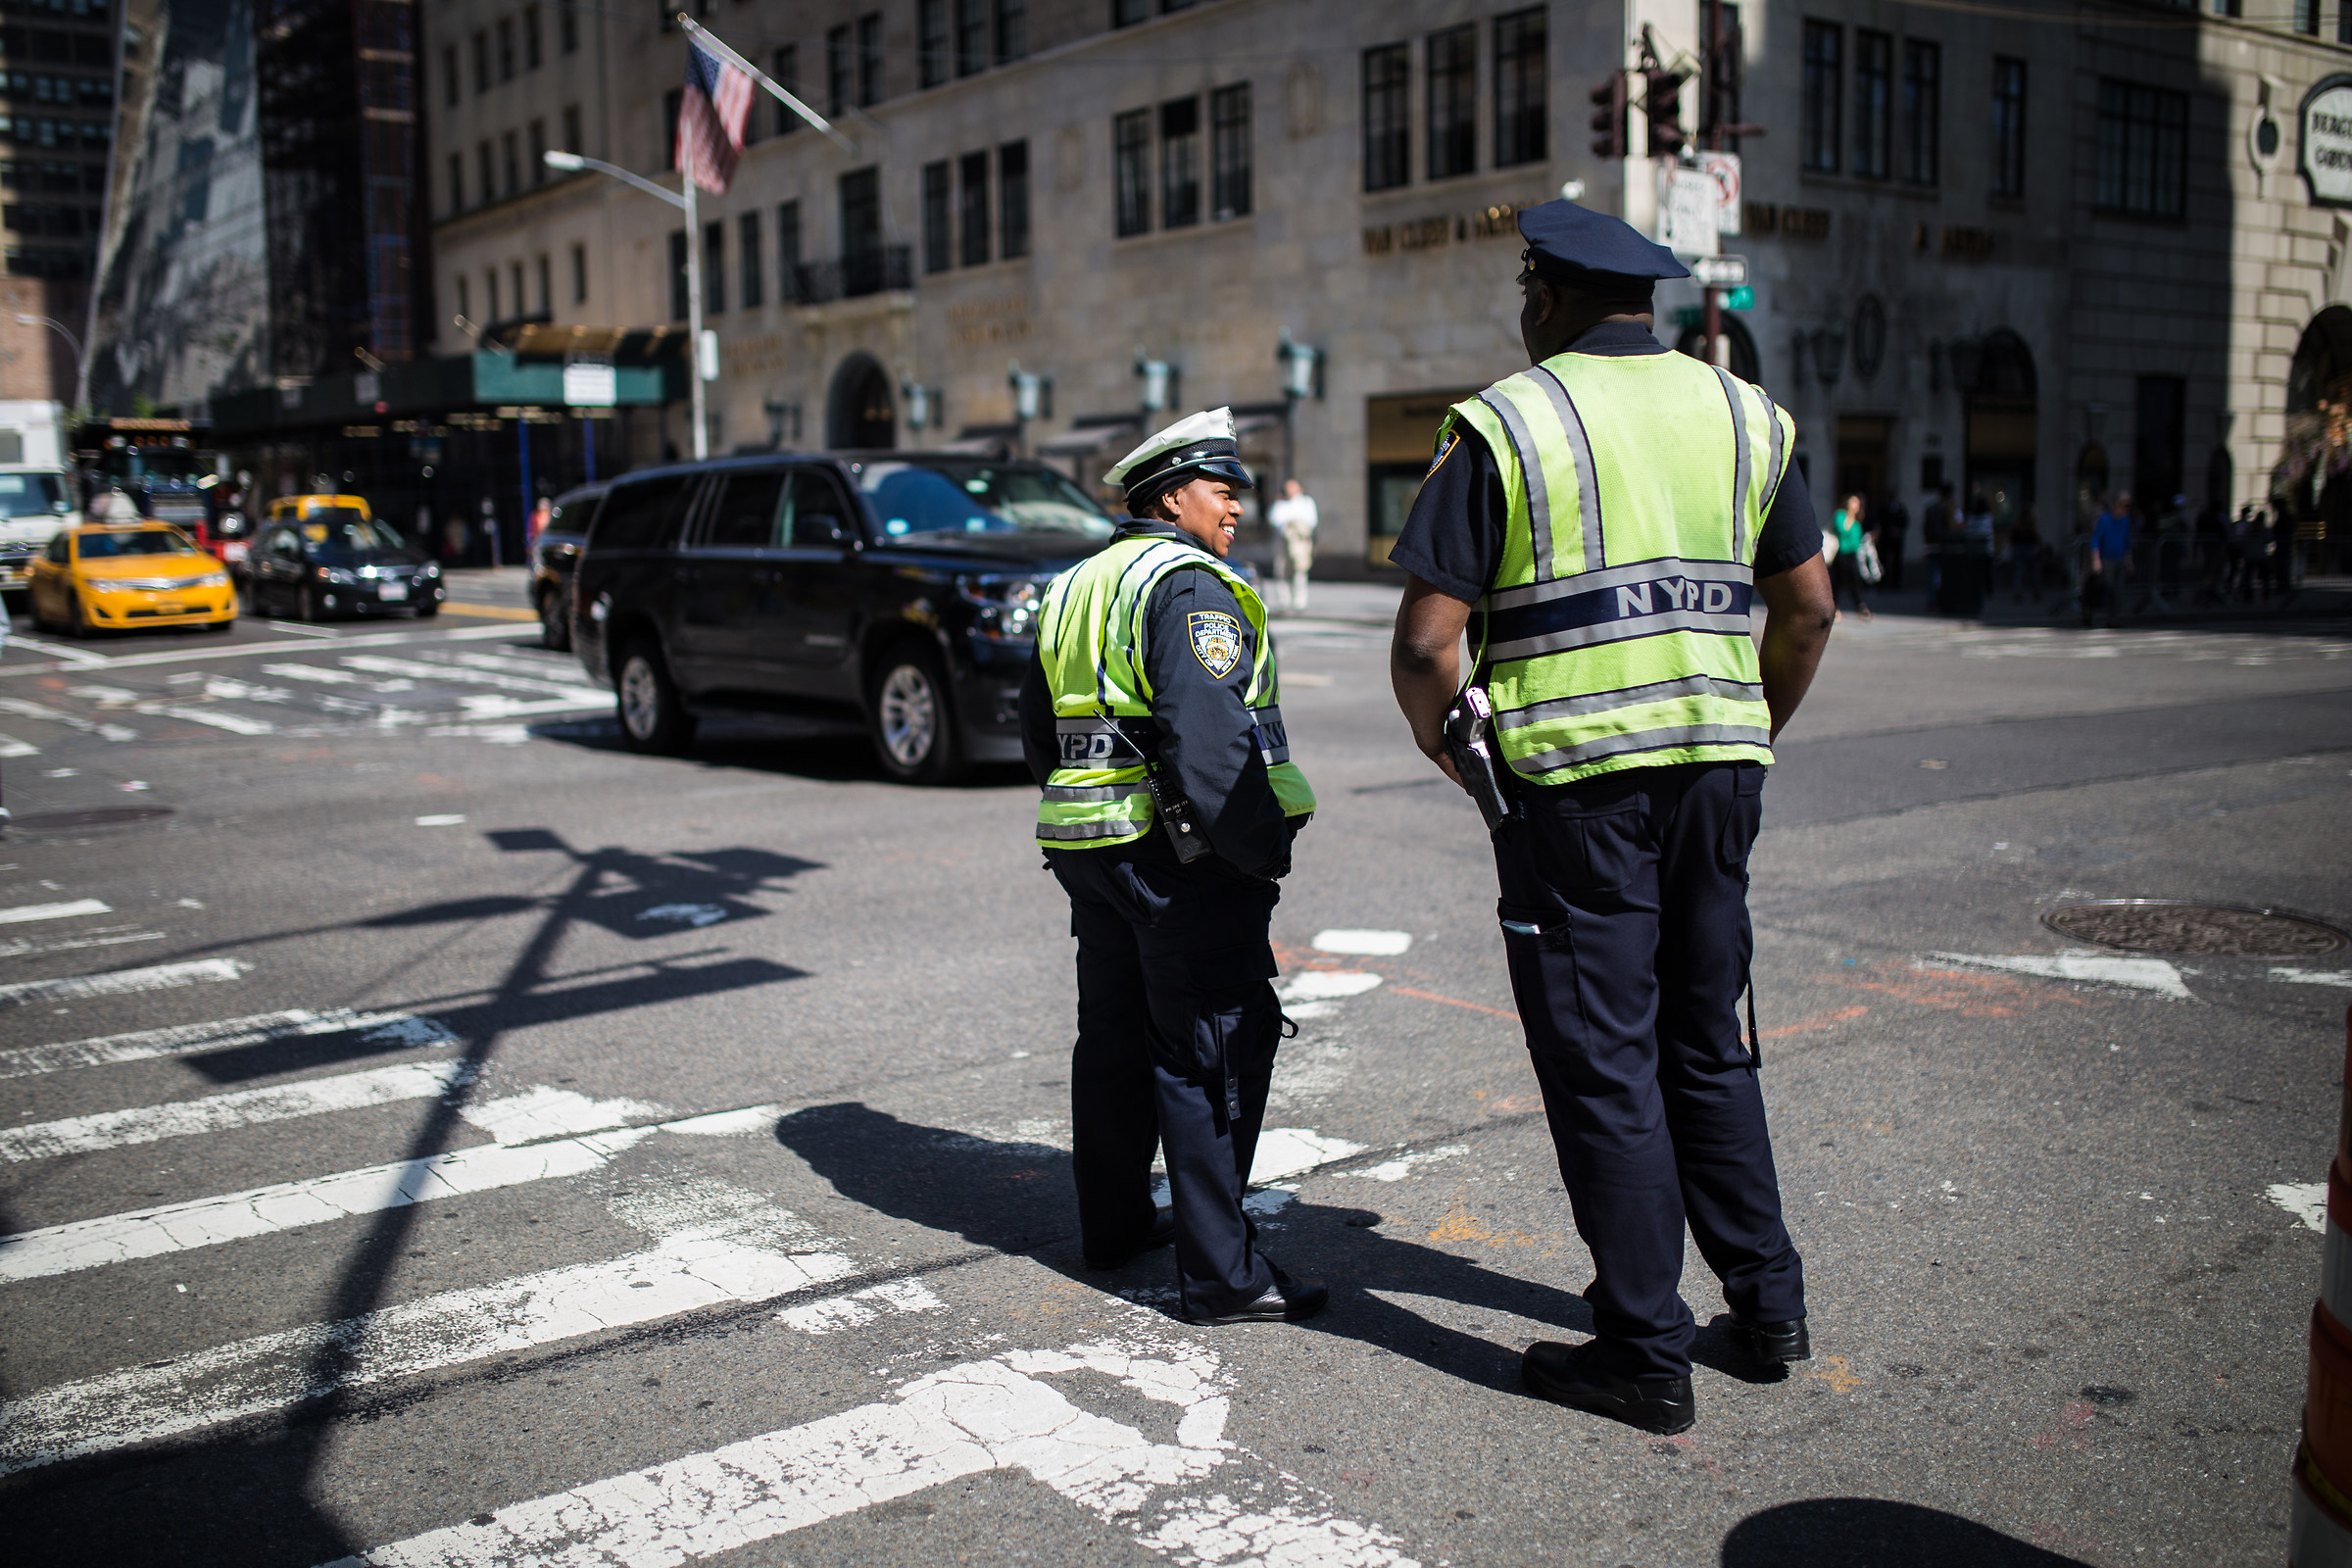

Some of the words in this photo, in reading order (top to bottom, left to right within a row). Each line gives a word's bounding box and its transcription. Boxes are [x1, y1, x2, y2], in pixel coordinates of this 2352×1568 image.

[1616, 577, 1733, 617] NYPD
[1199, 613, 1231, 623] TRAFFIC
[1204, 622, 1229, 632] POLICE
[1196, 629, 1237, 640] DEPARTMENT
[1259, 721, 1286, 749] NY
[1057, 733, 1113, 760] YPD
